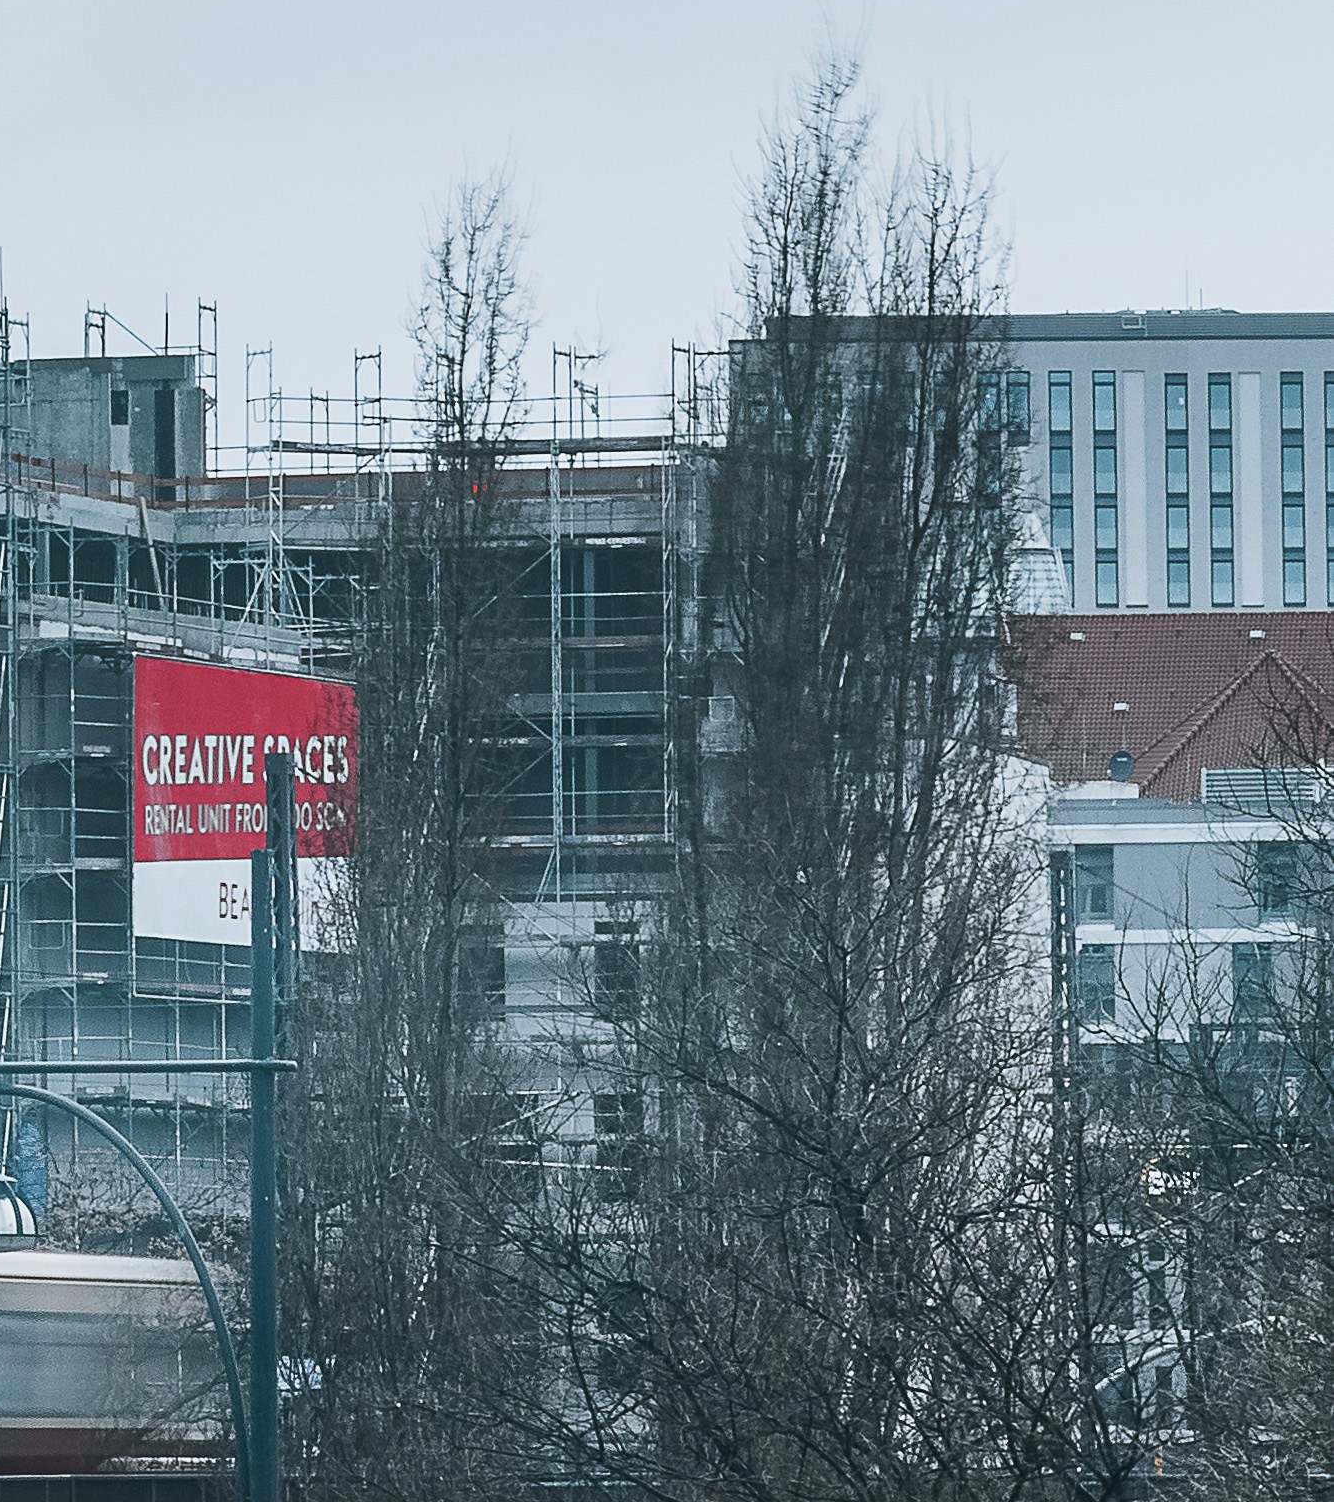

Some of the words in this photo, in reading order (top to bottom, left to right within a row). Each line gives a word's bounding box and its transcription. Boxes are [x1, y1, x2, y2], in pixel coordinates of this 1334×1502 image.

[142, 734, 255, 786] CREATIVE
[144, 803, 194, 835] RENTAL
[197, 803, 231, 834] UNIT
[234, 802, 267, 833] FRO
